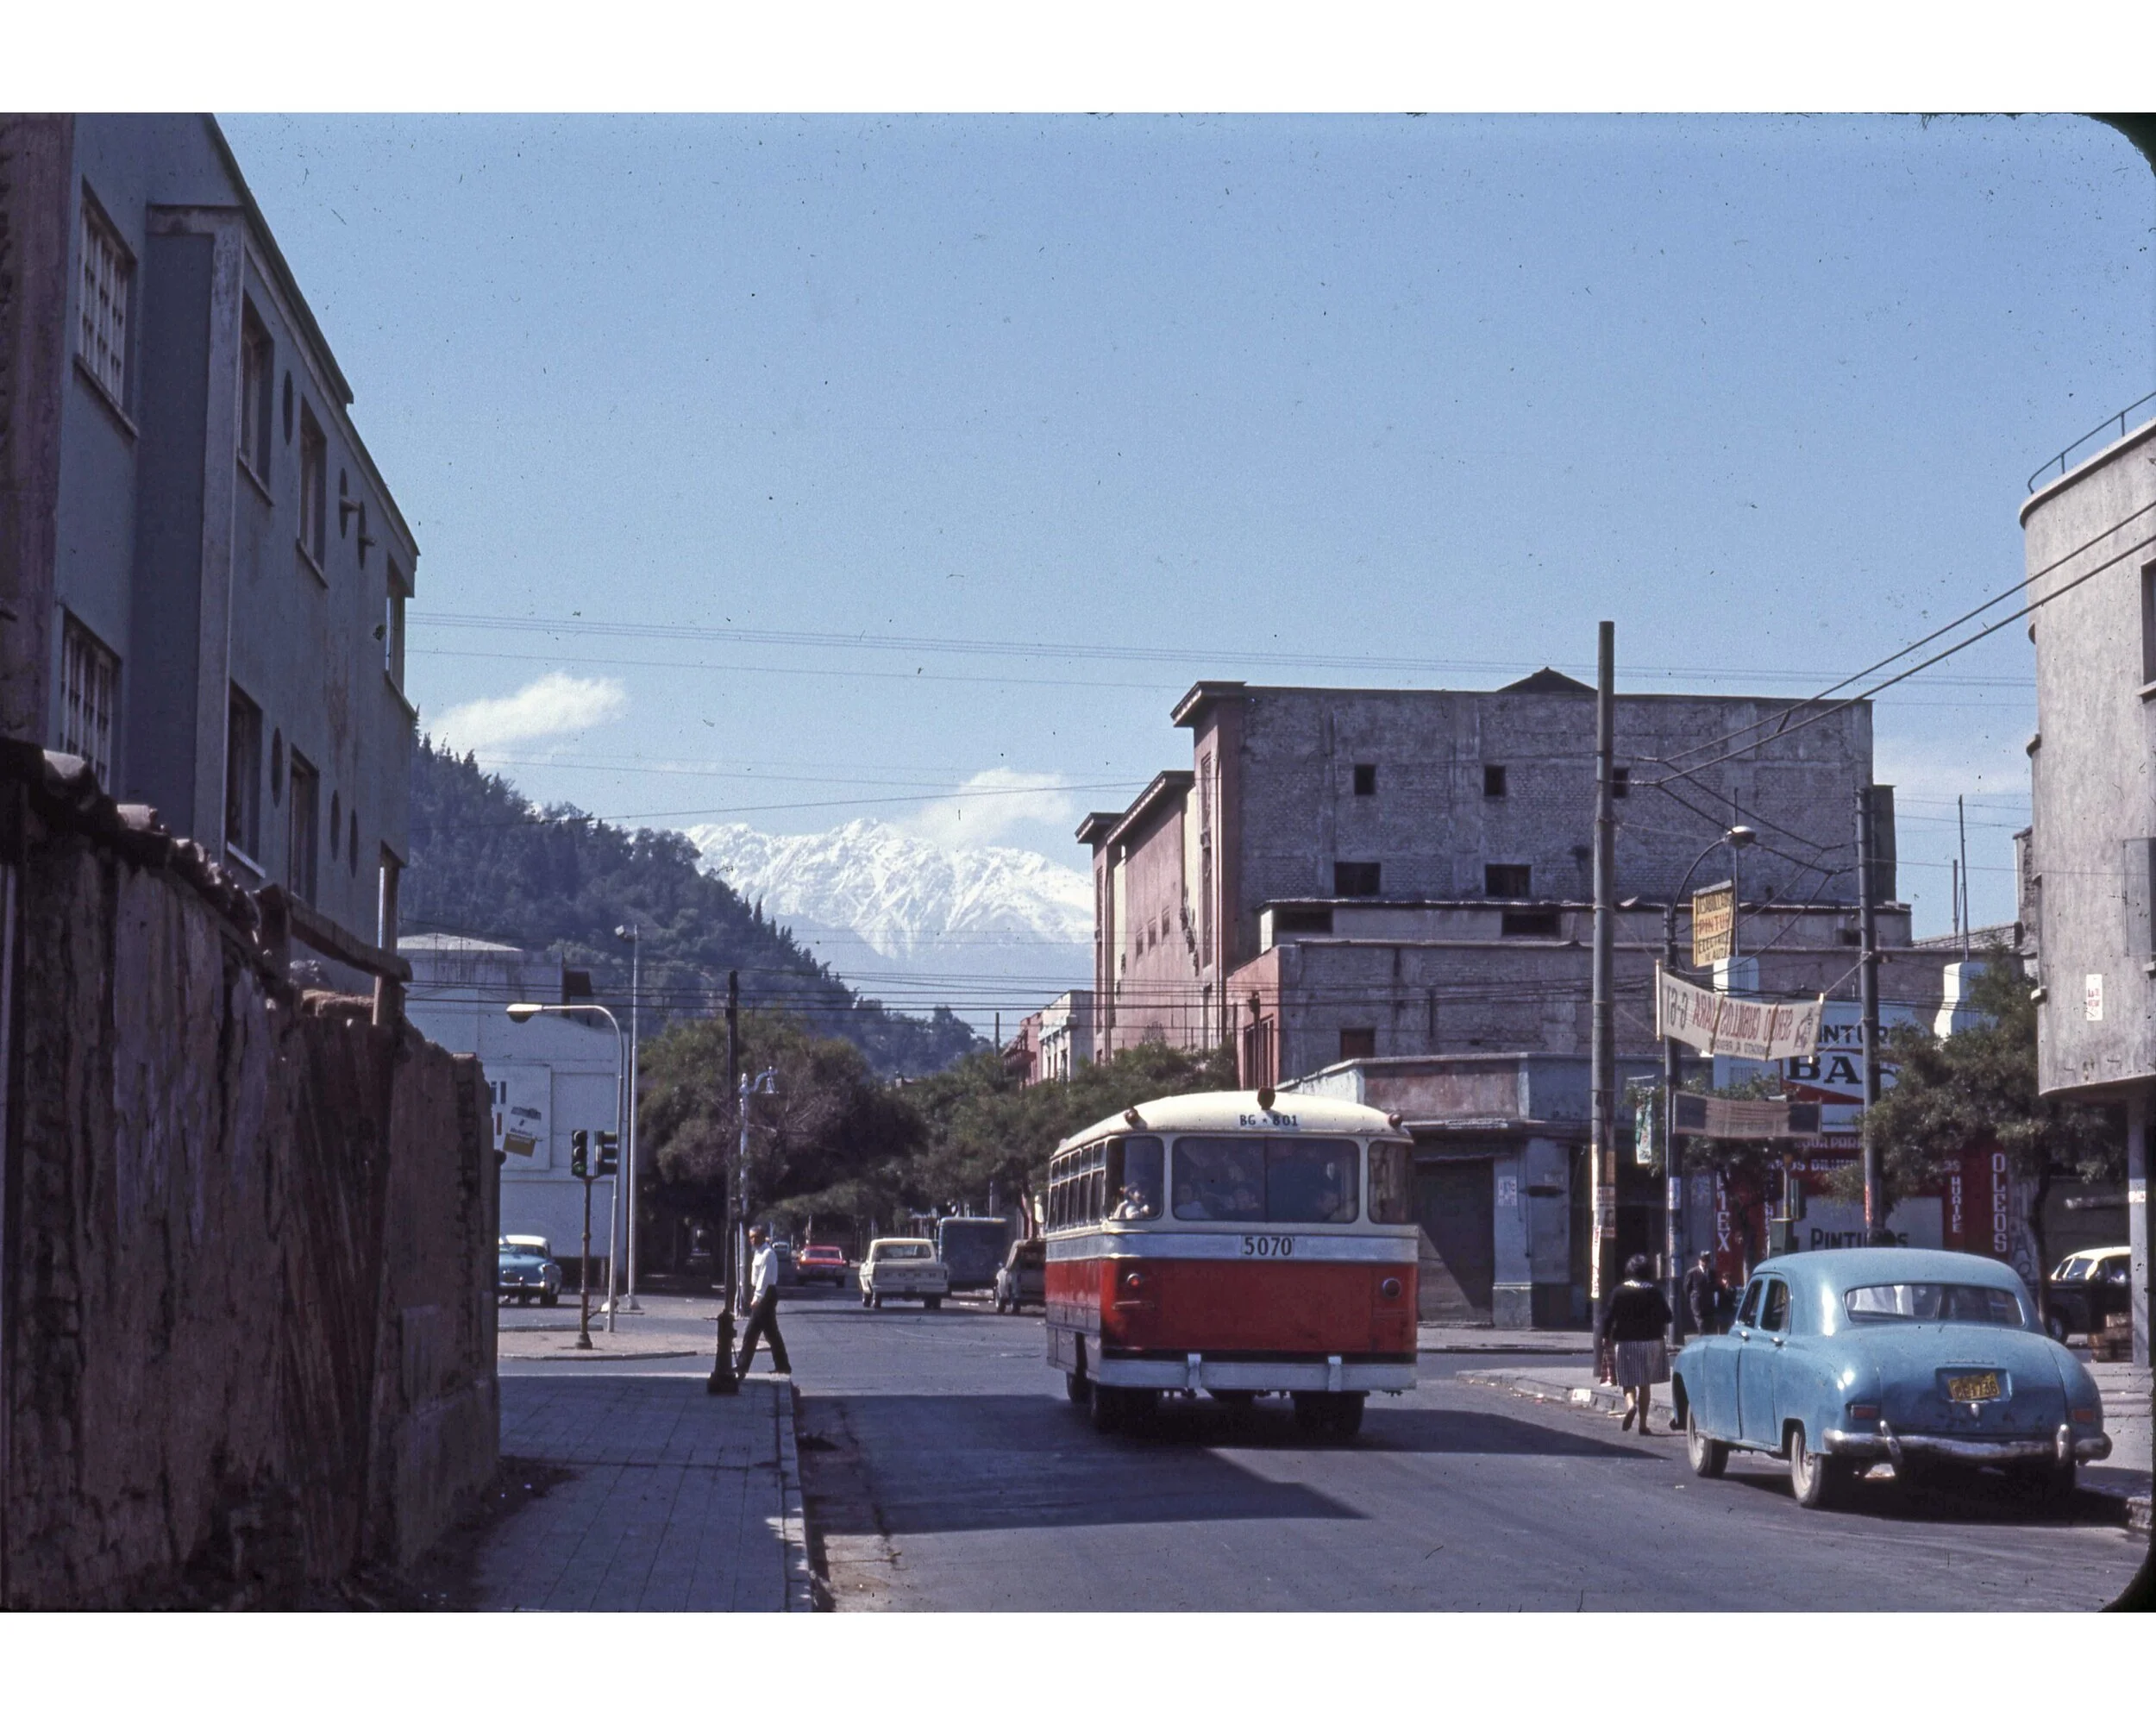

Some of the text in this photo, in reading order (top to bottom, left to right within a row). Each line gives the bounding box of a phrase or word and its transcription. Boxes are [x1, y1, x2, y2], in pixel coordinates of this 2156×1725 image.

[1239, 1114, 1298, 1126] BG 801
[1951, 1176, 1962, 1233] HUAIPE
[1992, 1152, 2007, 1252] OLEOS
[1244, 1236, 1293, 1257] 5070
